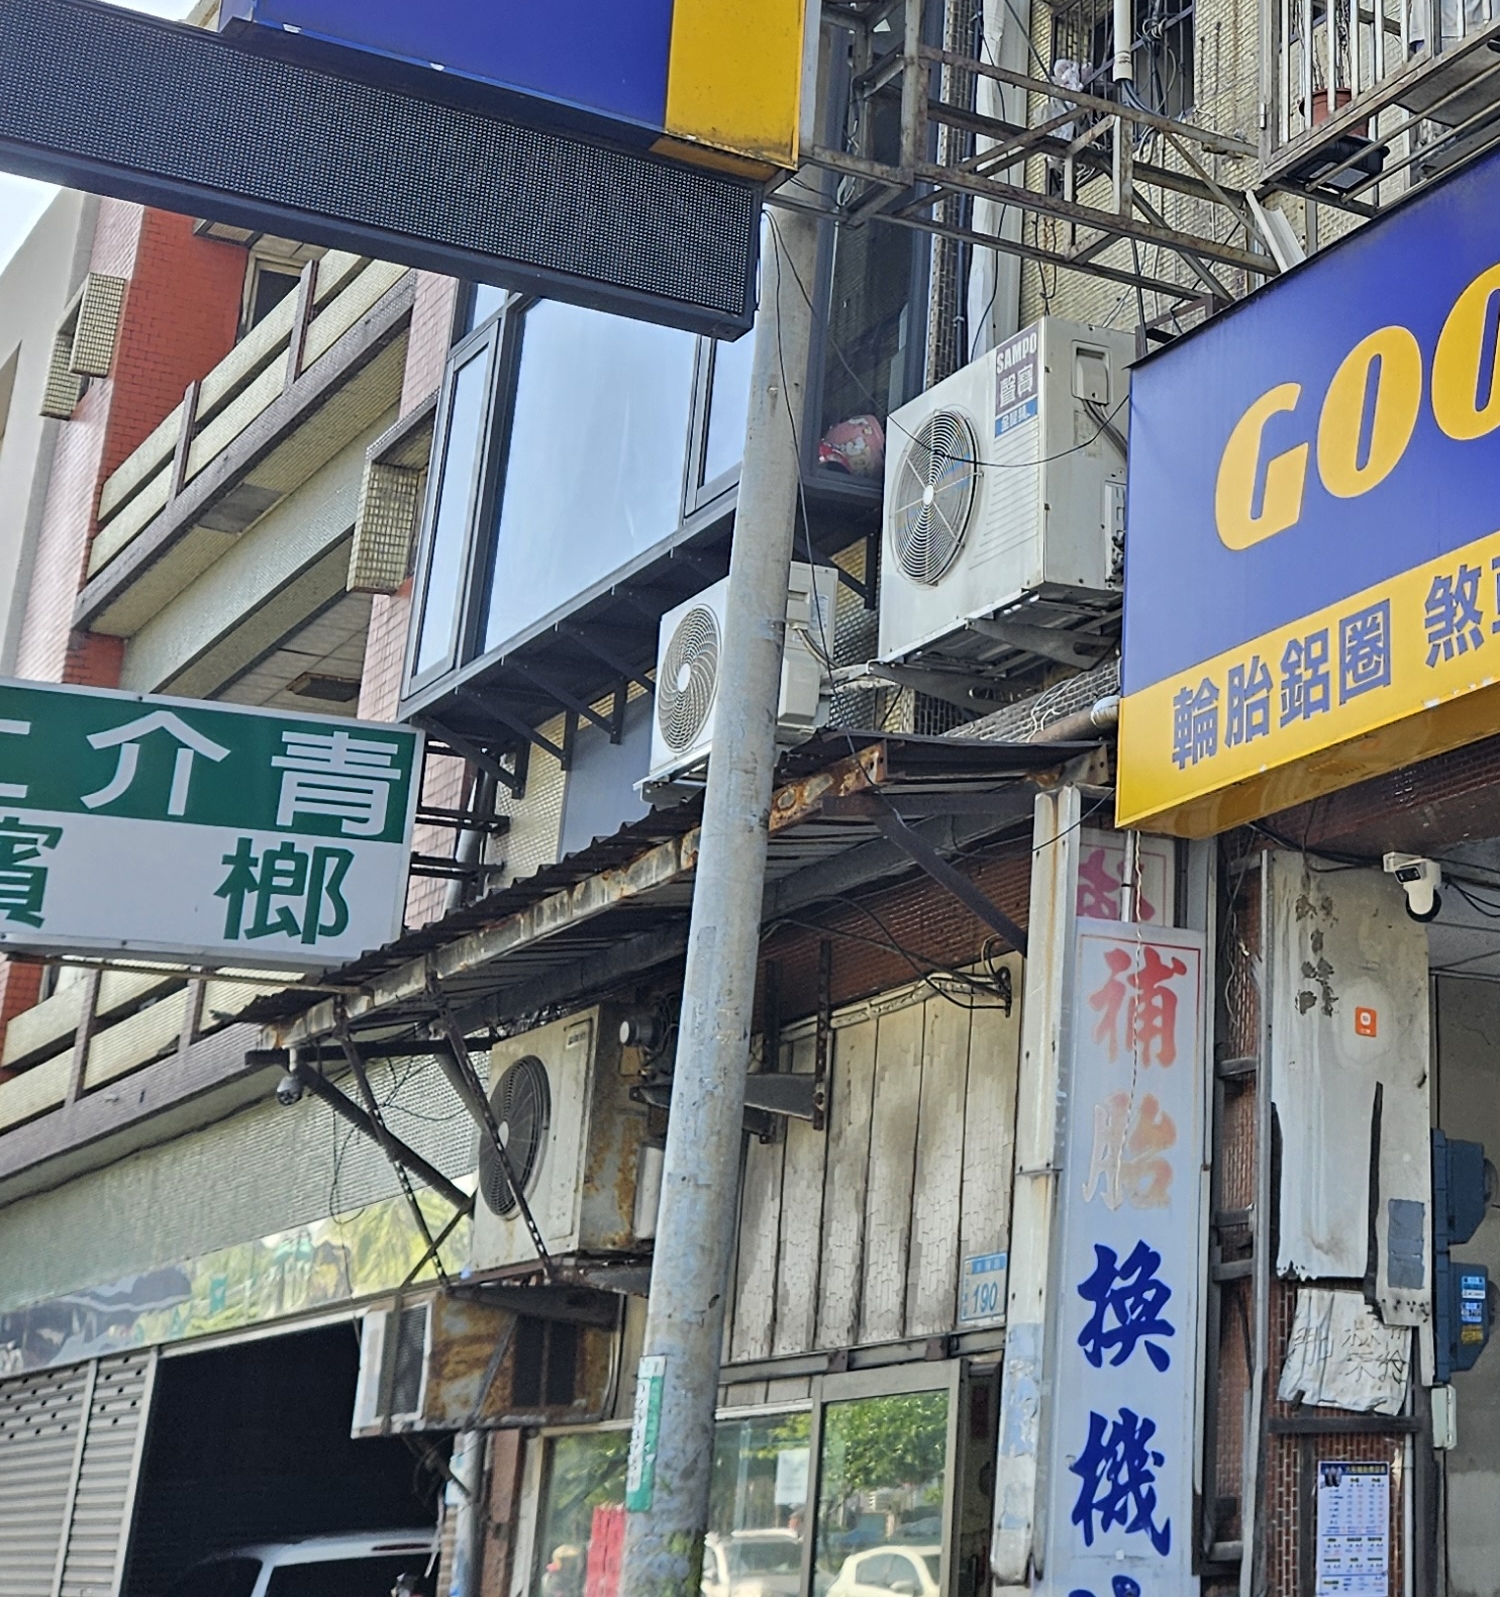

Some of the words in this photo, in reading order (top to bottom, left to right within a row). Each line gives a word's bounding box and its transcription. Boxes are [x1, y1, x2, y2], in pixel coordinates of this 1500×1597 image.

[996, 332, 1037, 374] SAMPO
[1171, 598, 1393, 771] 輪胎鋁圈
[0, 710, 401, 836] 介青
[971, 1281, 998, 1314] 190
[1069, 944, 1189, 1597] 補胎換機
